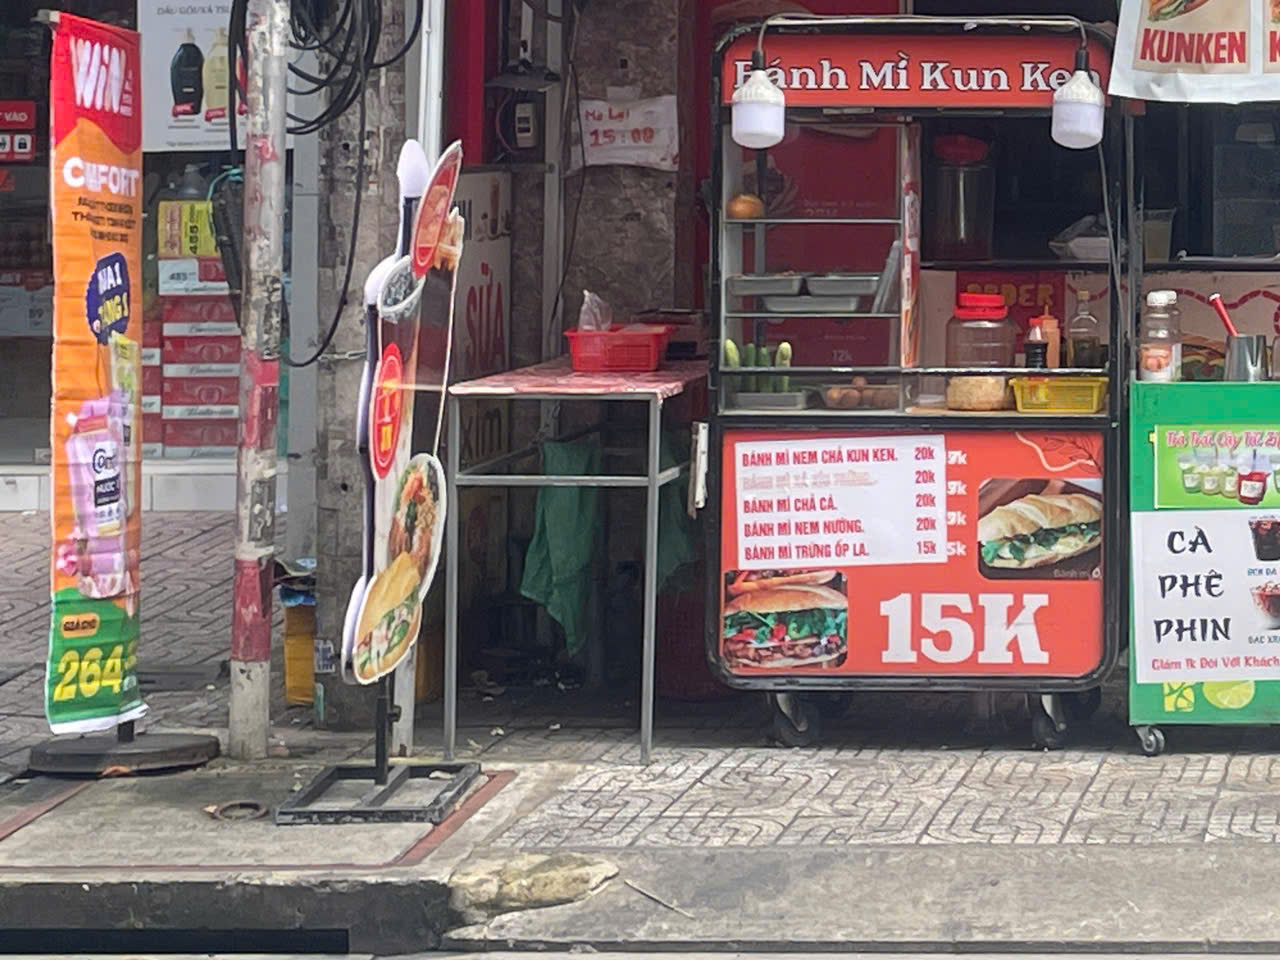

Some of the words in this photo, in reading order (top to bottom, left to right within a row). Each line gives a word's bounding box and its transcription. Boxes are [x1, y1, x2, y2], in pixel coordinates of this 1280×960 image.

[1140, 28, 1247, 64] KUNKEN
[858, 52, 910, 91] Mì
[920, 62, 1010, 91] Kun
[1020, 62, 1100, 91] Ke
[742, 448, 772, 467] BÁNH
[793, 448, 817, 464] NEM
[847, 448, 869, 463] KUN
[914, 446, 935, 460] 20k
[915, 470, 935, 484] 20k
[743, 496, 773, 513] BÁNH
[915, 493, 936, 508] 20k
[744, 519, 774, 538] BÁNH
[795, 520, 819, 535] NEM
[916, 517, 936, 531] 20k
[745, 543, 774, 560] BÁNH
[917, 540, 936, 554] 15k
[1158, 569, 1225, 599] PHÊ
[880, 592, 1049, 664] 15K
[1154, 617, 1232, 644] PHIN
[54, 645, 123, 702] 264
